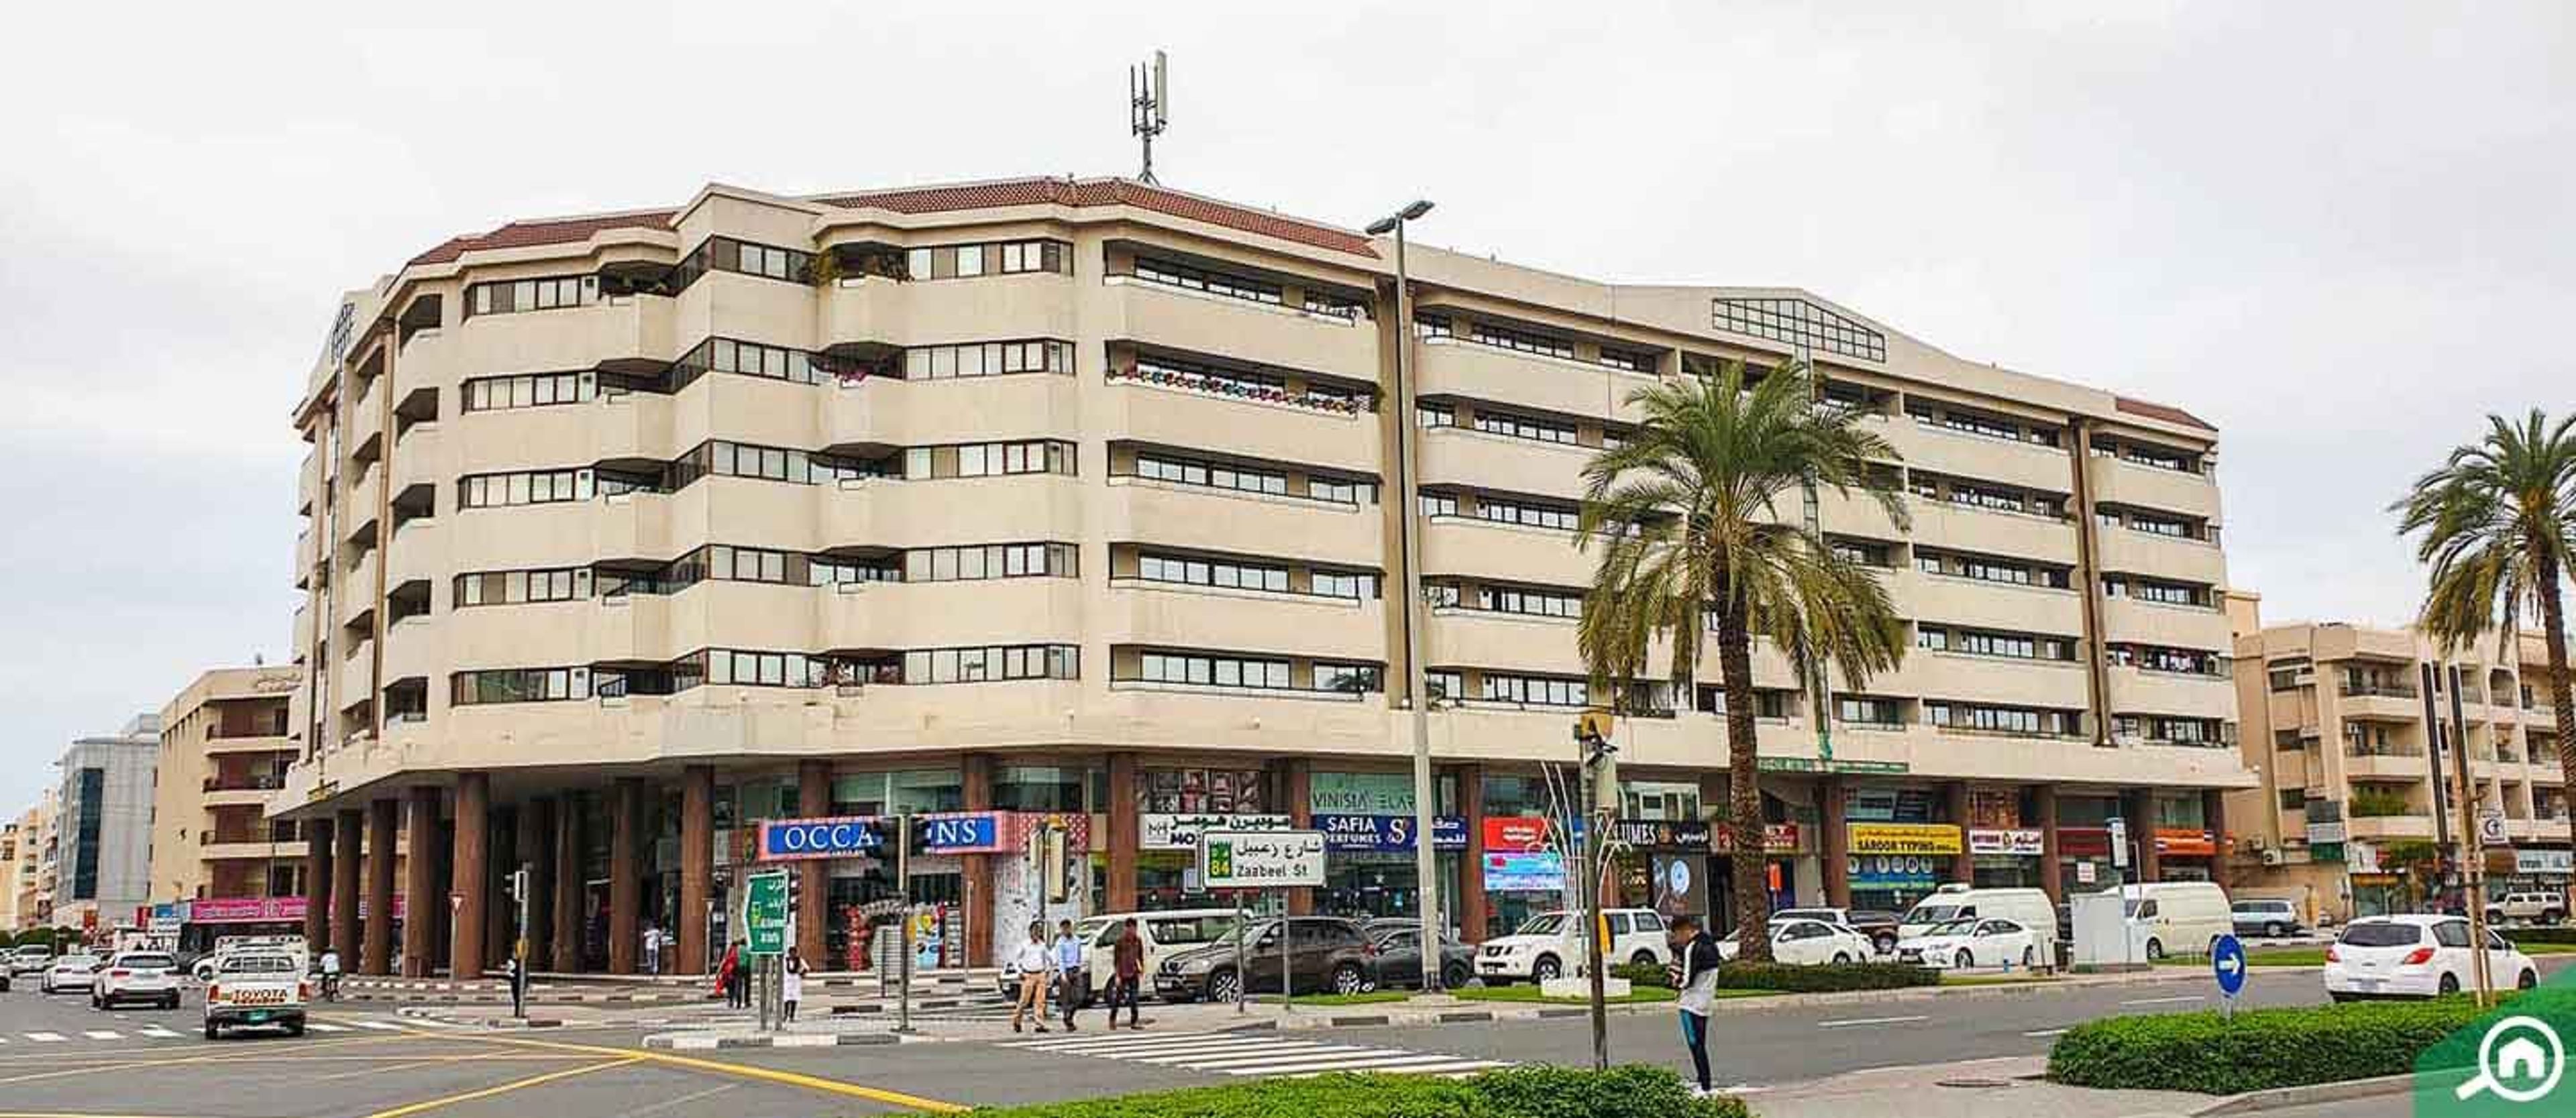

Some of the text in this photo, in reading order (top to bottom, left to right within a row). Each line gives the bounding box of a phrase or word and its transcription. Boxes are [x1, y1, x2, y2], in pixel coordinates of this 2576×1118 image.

[1328, 817, 1377, 832] SAFIA
[785, 820, 977, 850] OCCANS
[1236, 839, 1322, 859] شارع زعبيل
[1210, 860, 1230, 875] 84
[1236, 864, 1308, 877] Zaabeel St
[235, 989, 287, 998] TOYOTA
